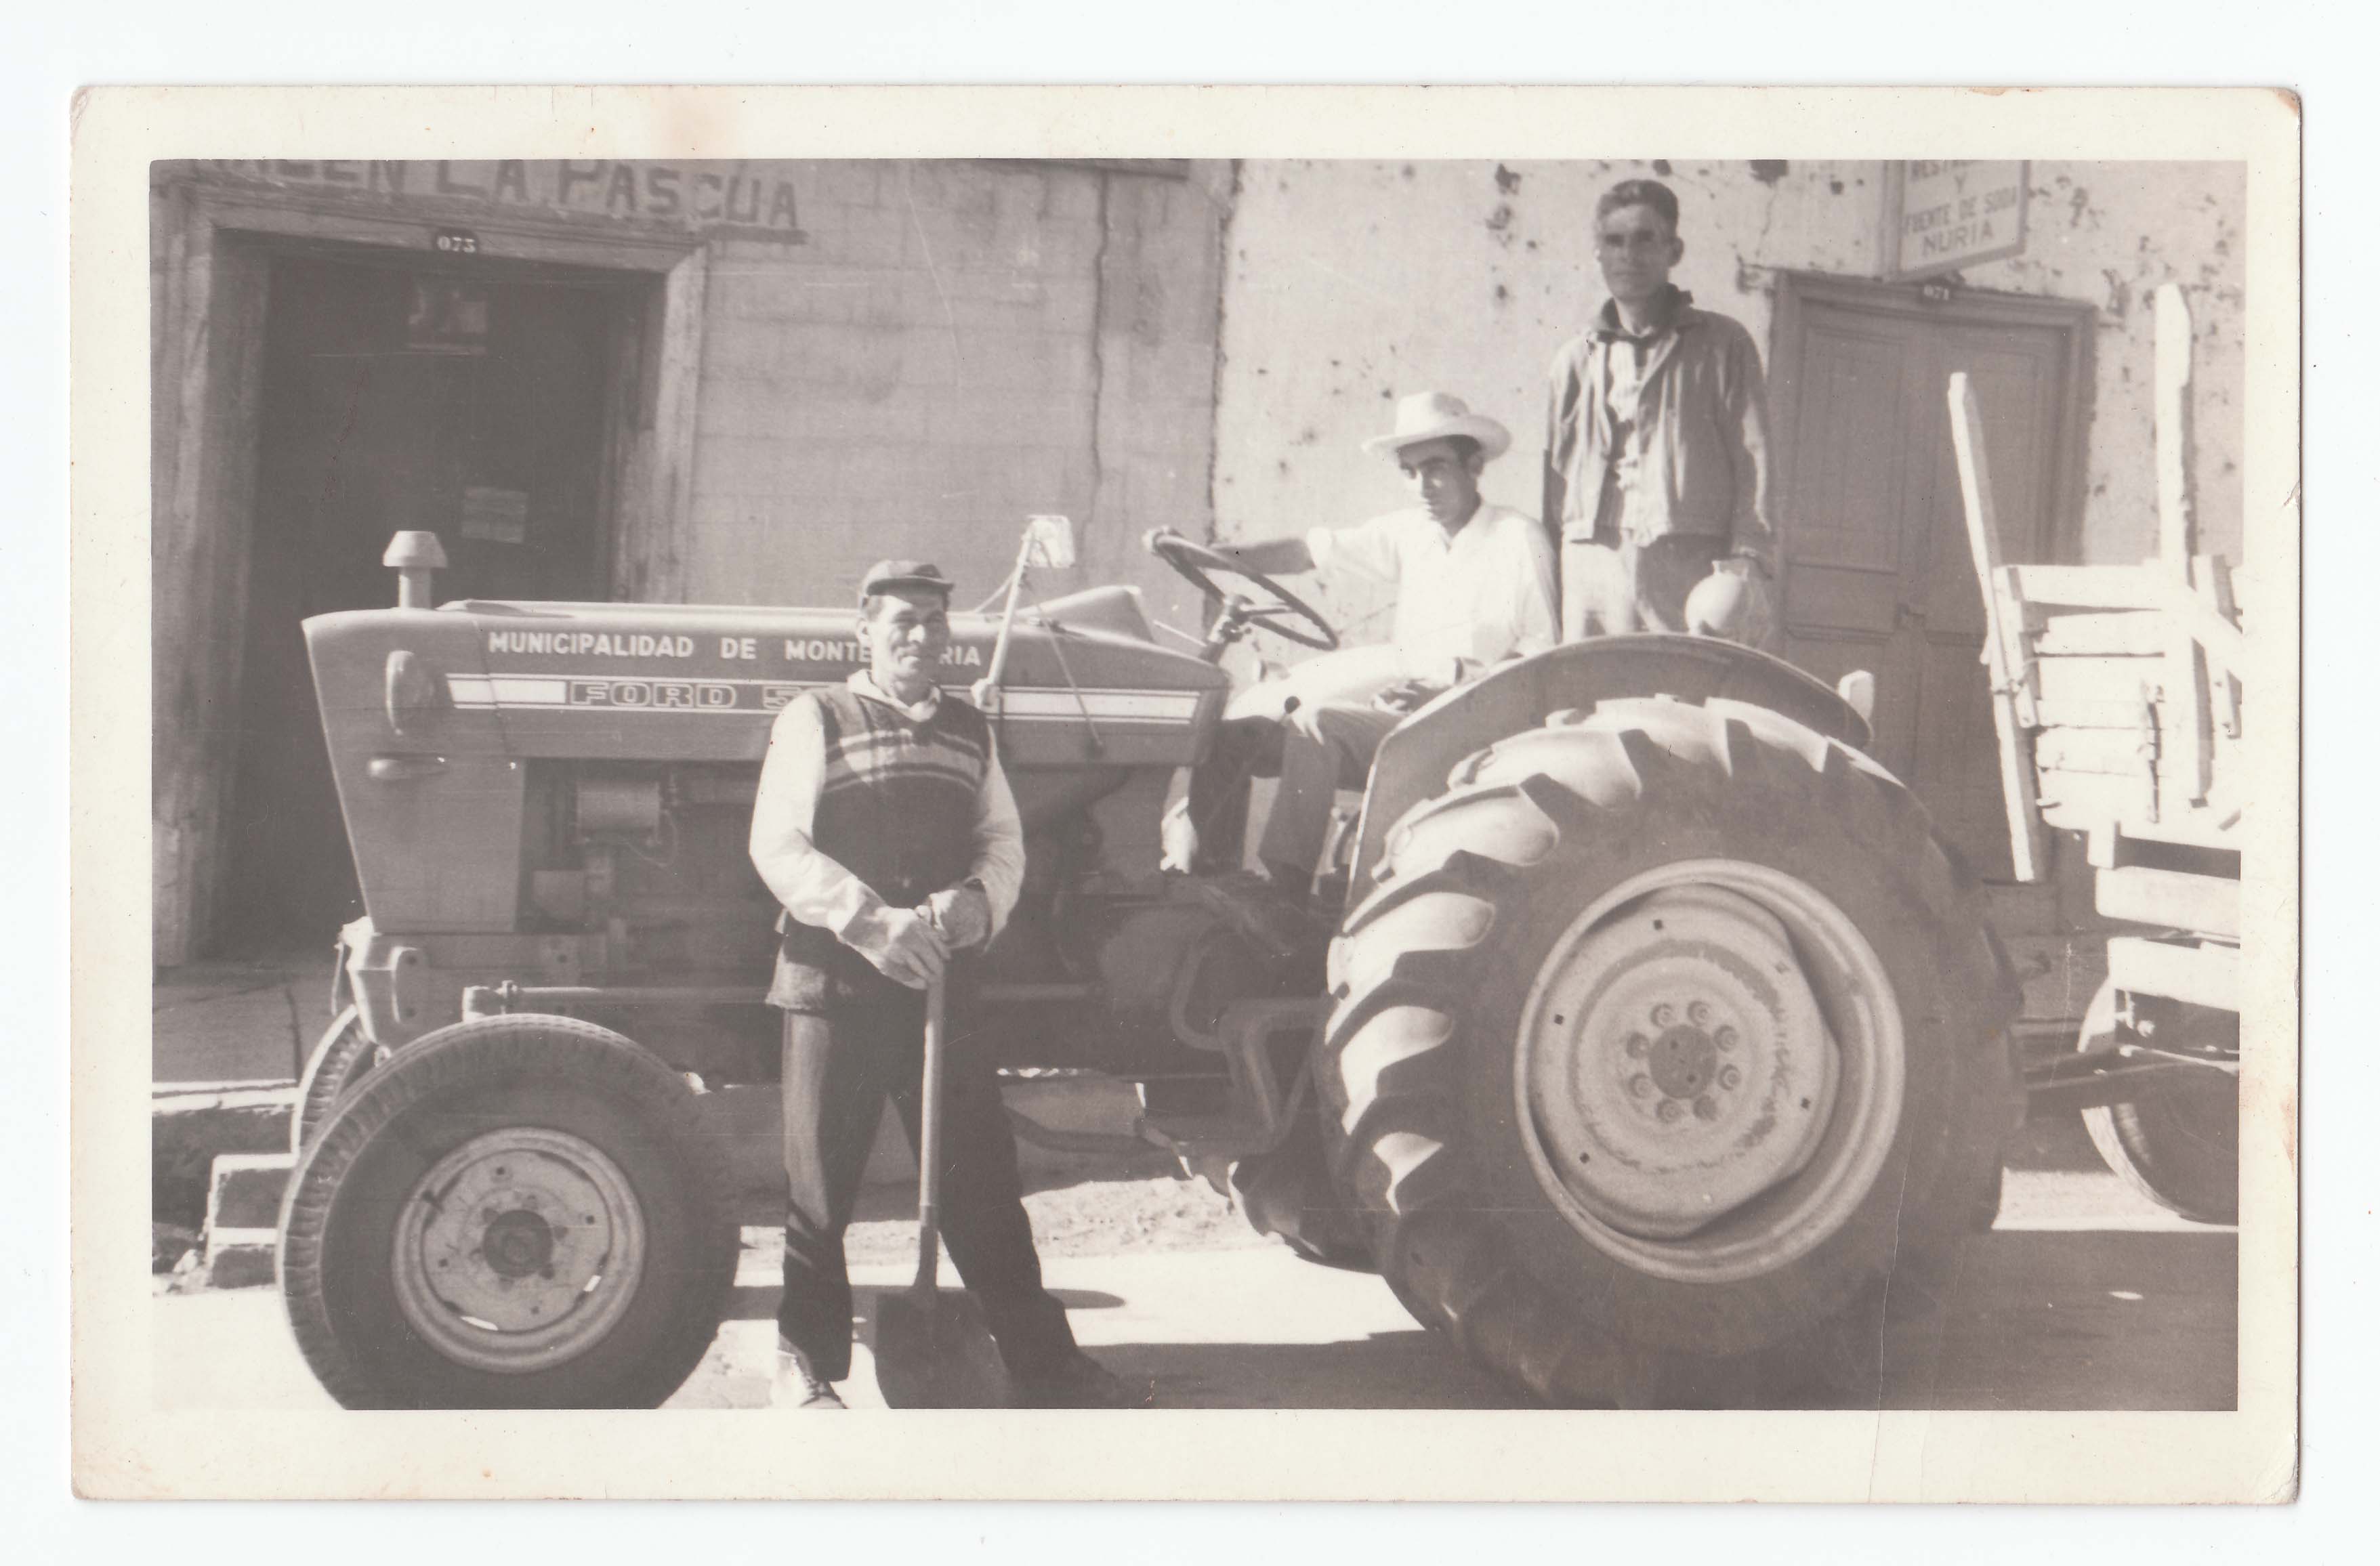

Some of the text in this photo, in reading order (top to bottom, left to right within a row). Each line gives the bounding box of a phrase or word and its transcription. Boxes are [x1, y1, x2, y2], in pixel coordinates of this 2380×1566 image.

[558, 160, 798, 229] PASCUA
[1954, 171, 1968, 194] Y
[1959, 196, 1978, 221] DE
[1922, 219, 1994, 257] NURIA
[488, 631, 694, 658] MUNICIPALIDAD
[719, 637, 757, 660] DE
[784, 639, 872, 663] MONTE
[569, 681, 737, 708] FORD
